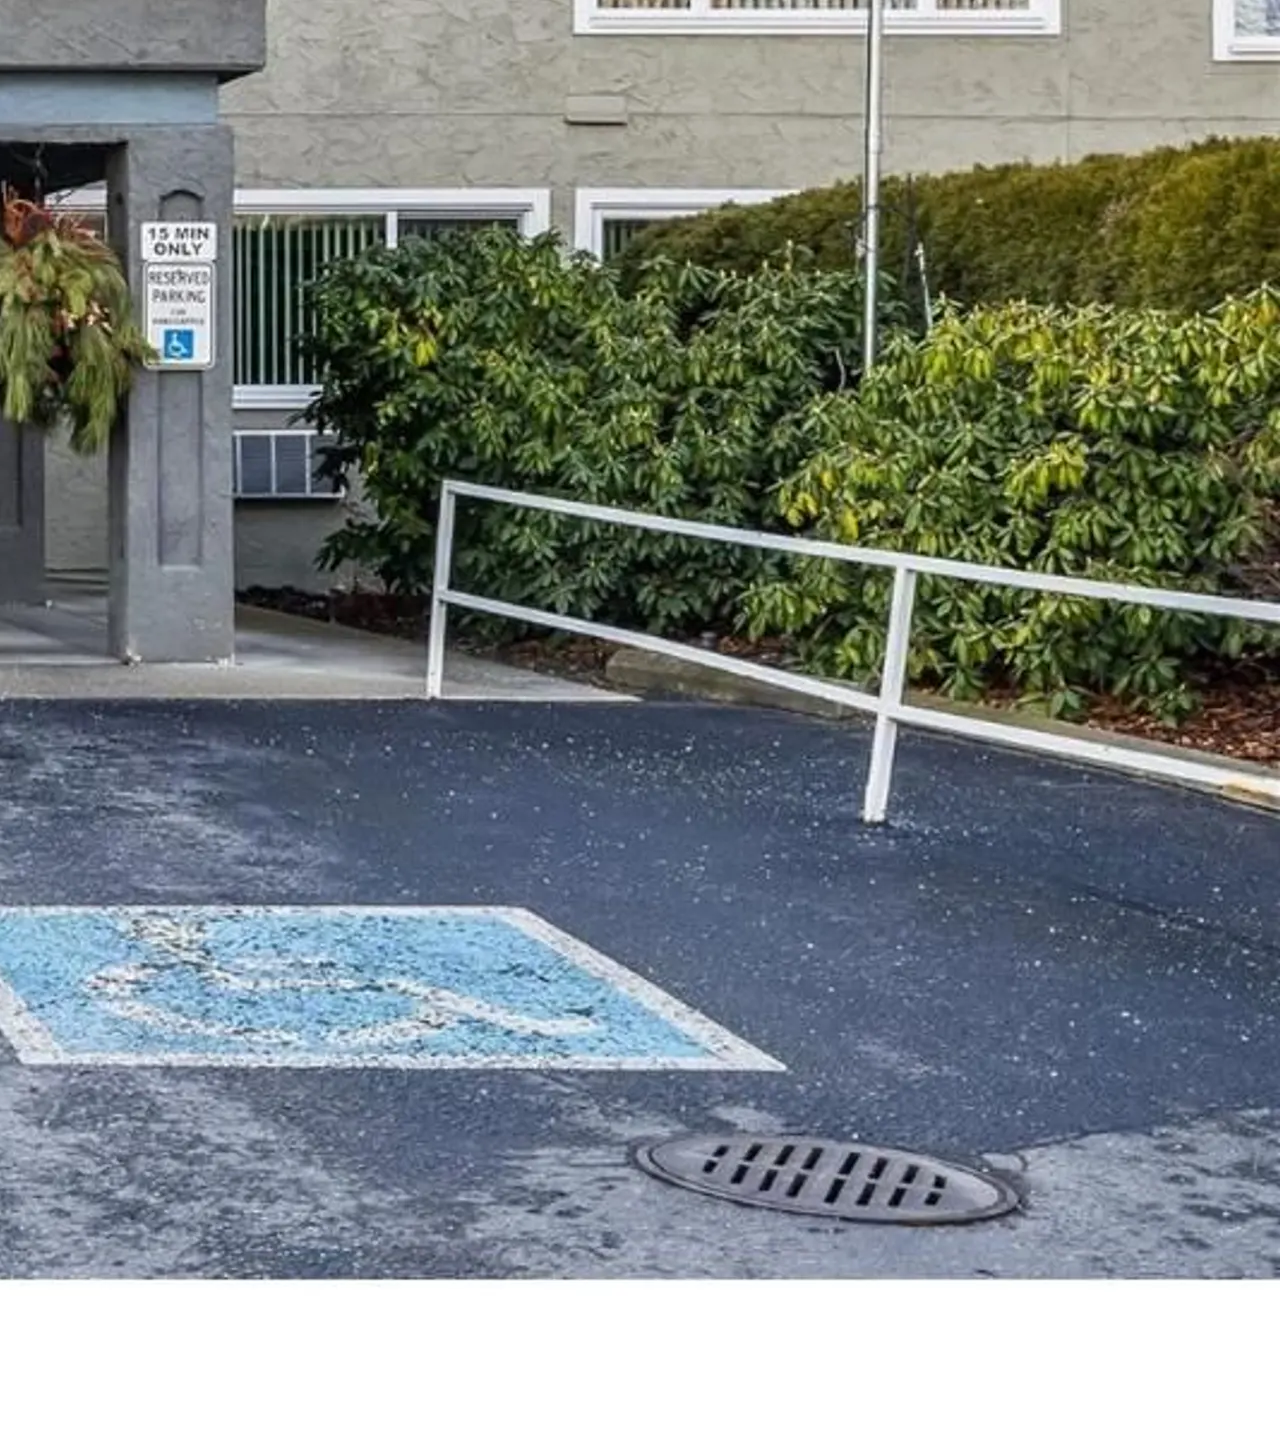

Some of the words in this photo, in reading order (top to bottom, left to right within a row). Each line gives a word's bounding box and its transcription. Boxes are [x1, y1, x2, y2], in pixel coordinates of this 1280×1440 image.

[148, 228, 169, 240] 15
[174, 228, 209, 240] MIN
[153, 243, 203, 256] ONLY
[148, 271, 210, 286] RESERVED
[151, 290, 206, 304] PARKING
